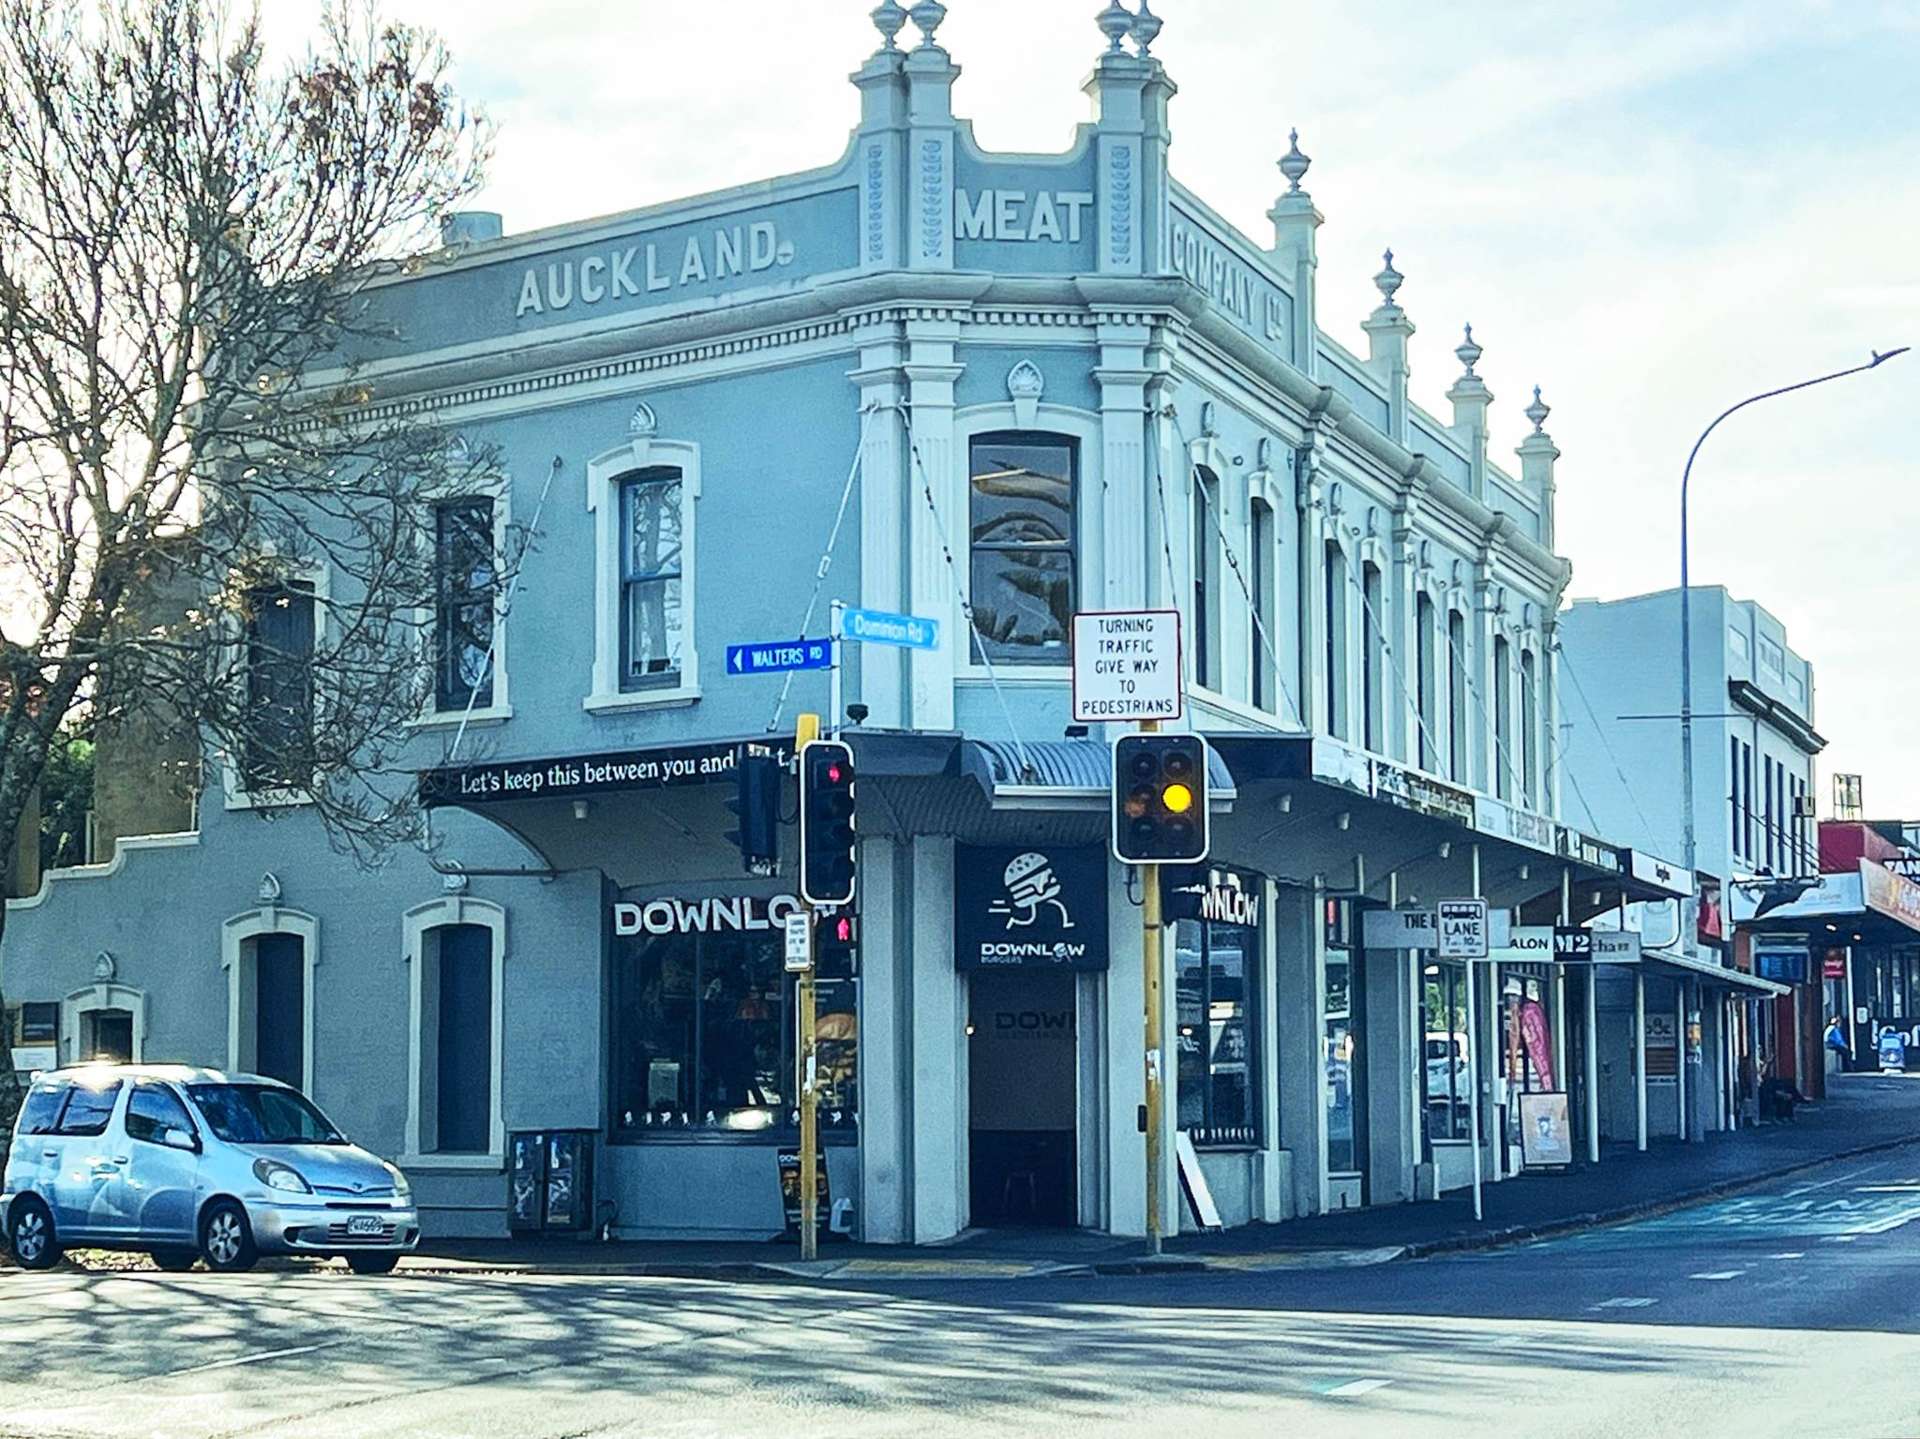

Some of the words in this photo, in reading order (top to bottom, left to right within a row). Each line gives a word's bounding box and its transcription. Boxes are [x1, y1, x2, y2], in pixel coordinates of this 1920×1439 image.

[953, 188, 1094, 243] MEAT
[1172, 224, 1257, 326] COMPANY
[908, 621, 923, 643] Rd
[1098, 618, 1154, 634] TURNING
[1098, 639, 1154, 654] TRAFFIC
[752, 647, 804, 667] WALTERS
[809, 646, 823, 660] RD
[1095, 659, 1125, 674] GIVE
[1133, 659, 1158, 674] WAY
[1119, 679, 1136, 694] TO
[1082, 699, 1173, 714] PEDESTRIANS
[461, 771, 500, 794] Let's
[504, 769, 544, 792] keep
[548, 764, 580, 786] this
[584, 762, 658, 784] between
[662, 759, 696, 782] you
[700, 749, 734, 774] and
[1199, 887, 1259, 927] WNLOW
[1403, 913, 1428, 929] THE
[1444, 922, 1480, 936] LANE
[981, 943, 1085, 957] DOWNLOW
[1510, 938, 1548, 950] ALON
[1555, 934, 1590, 953] M2
